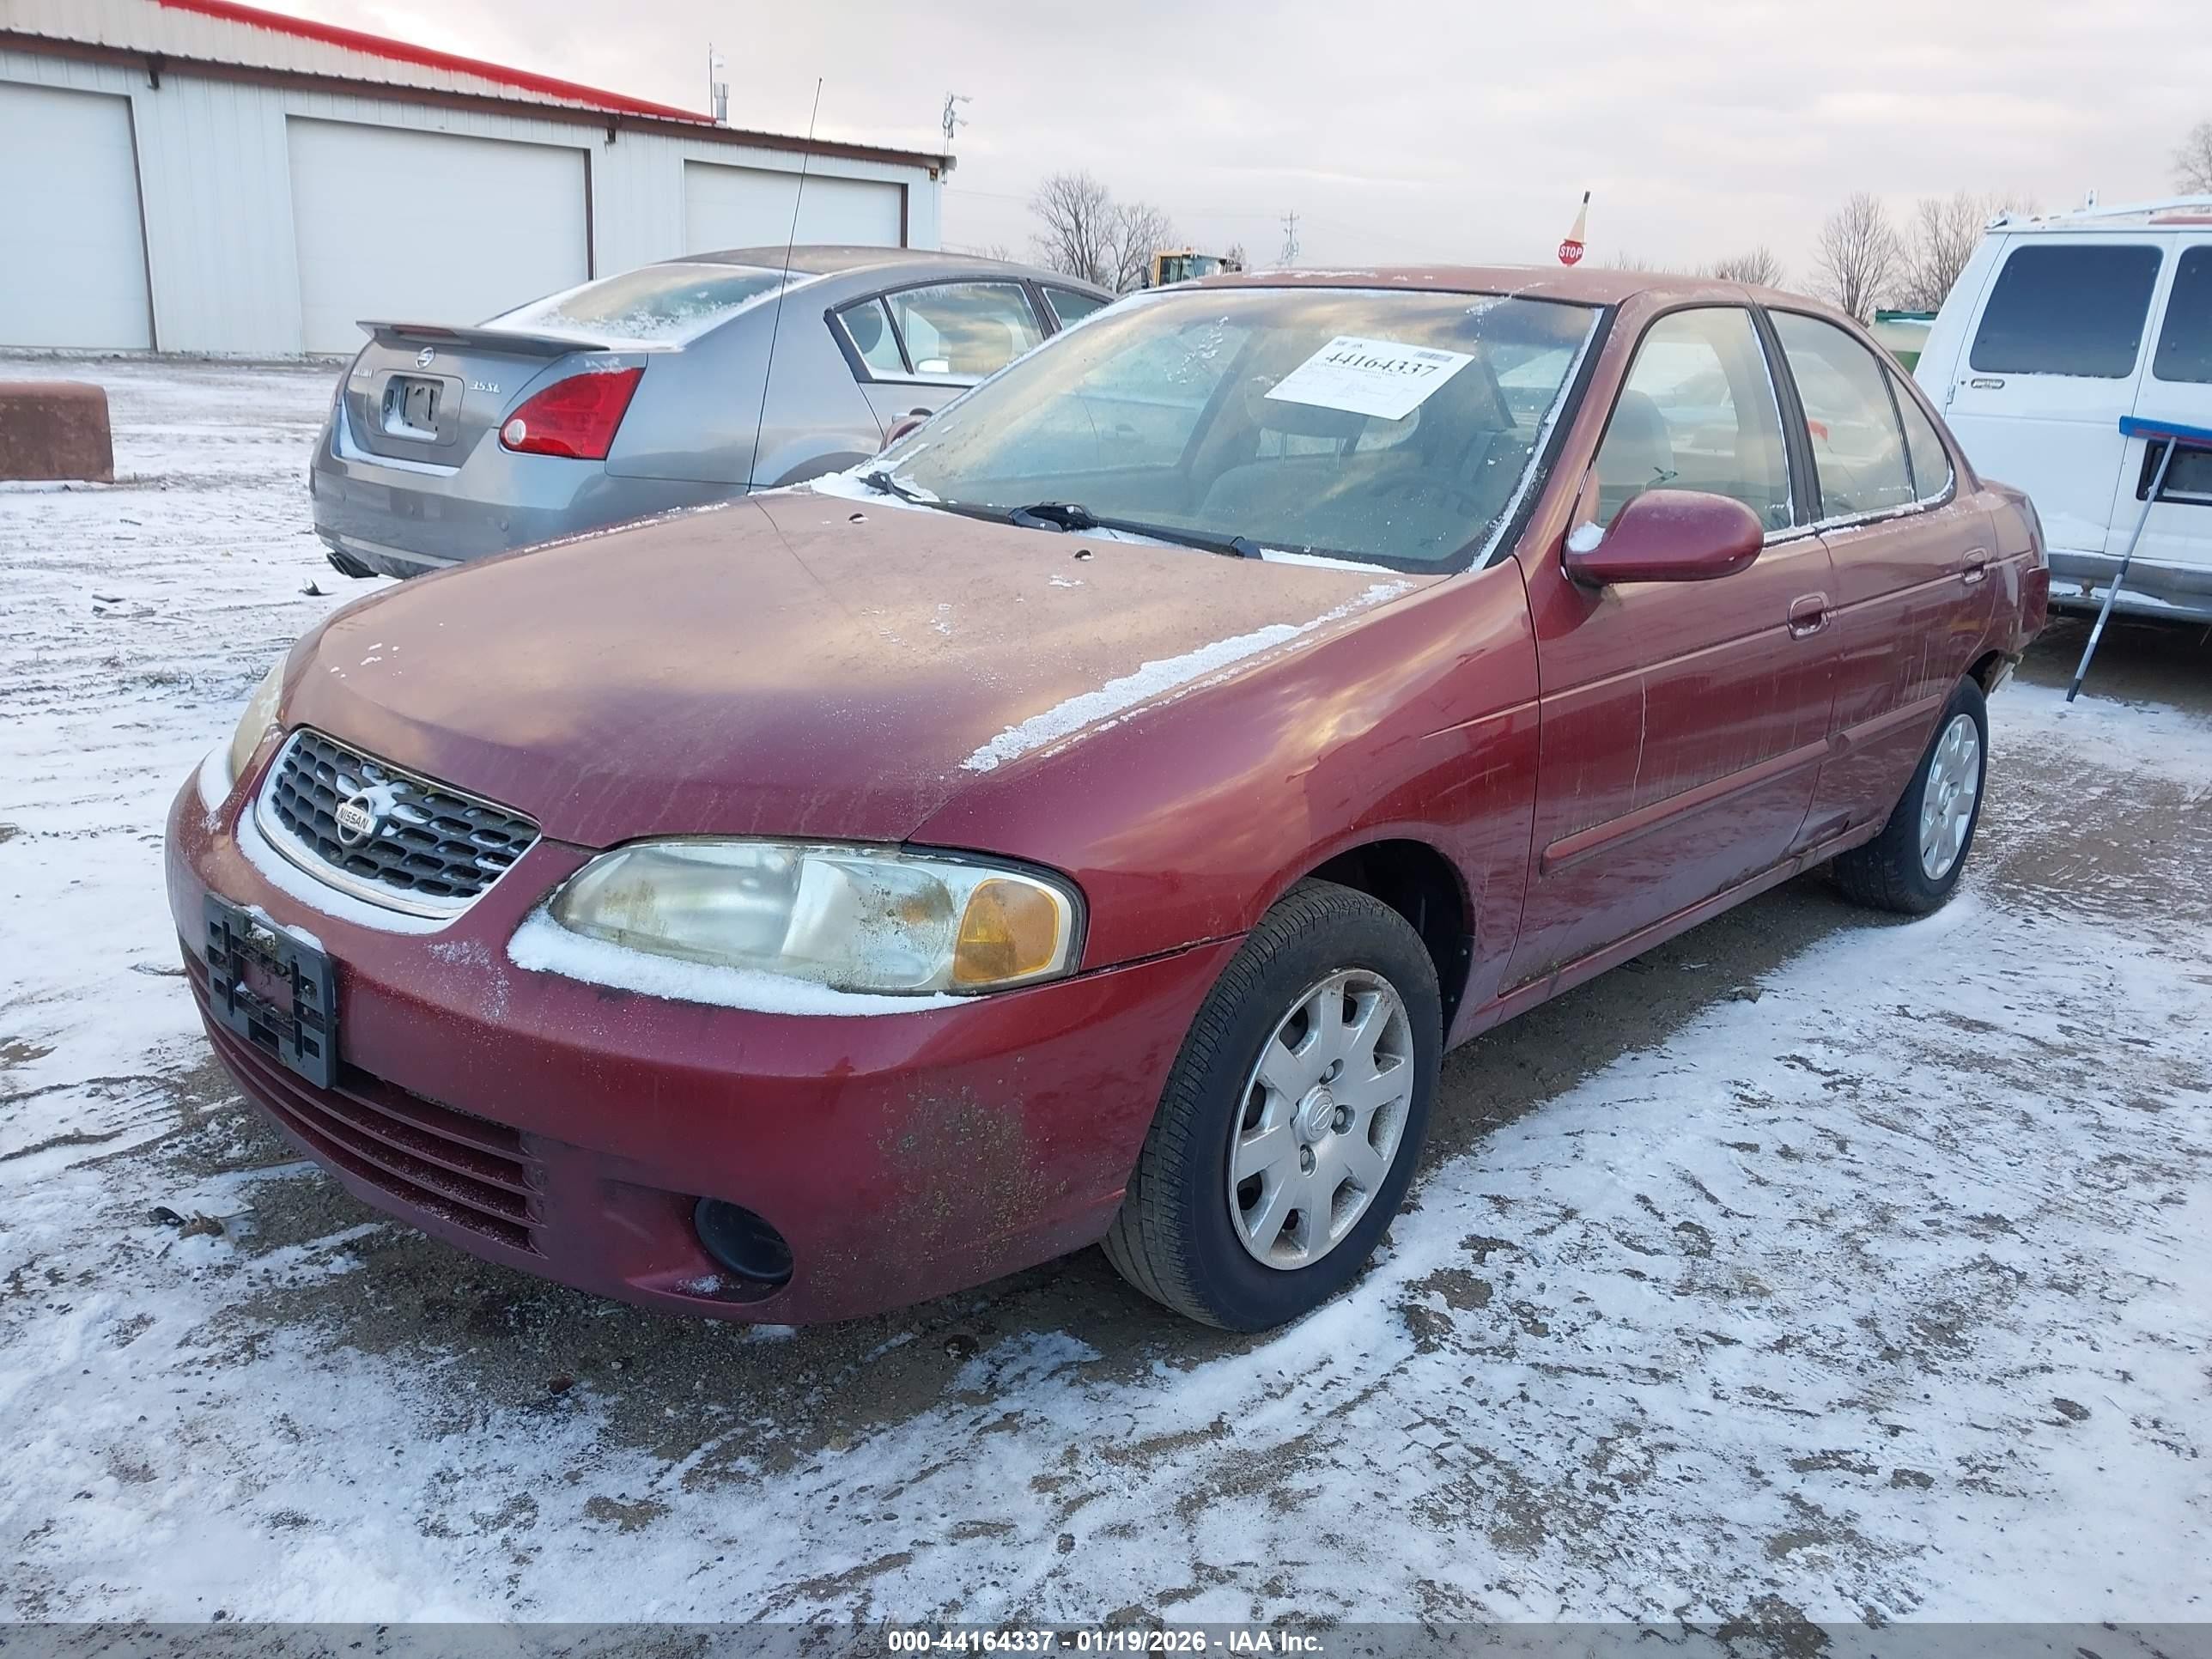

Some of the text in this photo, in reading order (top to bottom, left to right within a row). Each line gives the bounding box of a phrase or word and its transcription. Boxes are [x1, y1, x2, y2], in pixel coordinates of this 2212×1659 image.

[1559, 246, 1583, 258] STOP
[1326, 352, 1440, 377] 44164337
[338, 807, 369, 830] NISSAN
